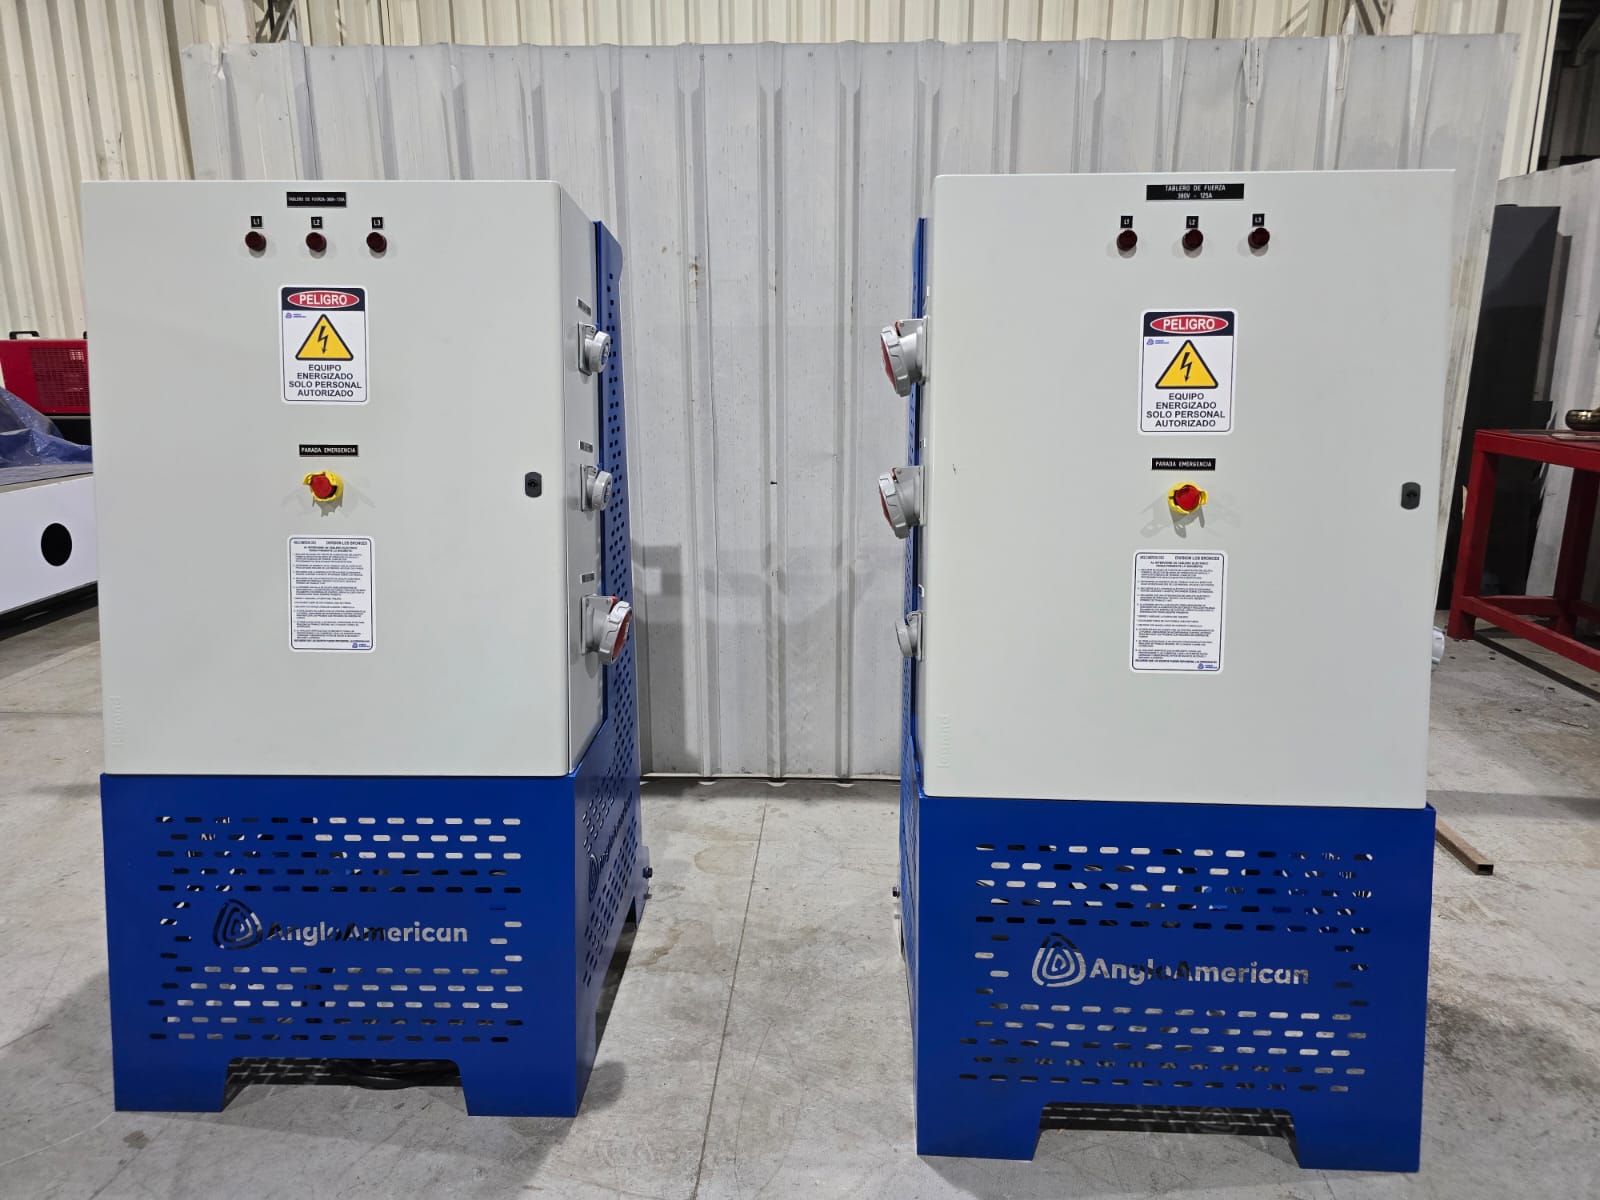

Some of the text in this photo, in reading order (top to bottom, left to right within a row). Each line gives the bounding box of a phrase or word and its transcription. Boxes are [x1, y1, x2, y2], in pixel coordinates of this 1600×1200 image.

[313, 218, 320, 226] L2
[1188, 218, 1196, 226] L2
[299, 294, 348, 305] PELIGRO
[1163, 318, 1216, 330] PELIGRO
[308, 364, 342, 372] EQUIPO
[297, 372, 353, 380] ENERGIZADO
[289, 380, 362, 389] SOLO PERSONAL
[297, 389, 354, 397] AUTORIZADO
[1168, 392, 1205, 401] EQUIPO
[1155, 401, 1217, 410] ENERGIZADO
[1146, 410, 1226, 419] SOLO PERSONAL
[1155, 419, 1216, 428] AUTORIZADO
[266, 921, 468, 947] AngloAmerican
[1089, 958, 1309, 986] AngloAmerican
